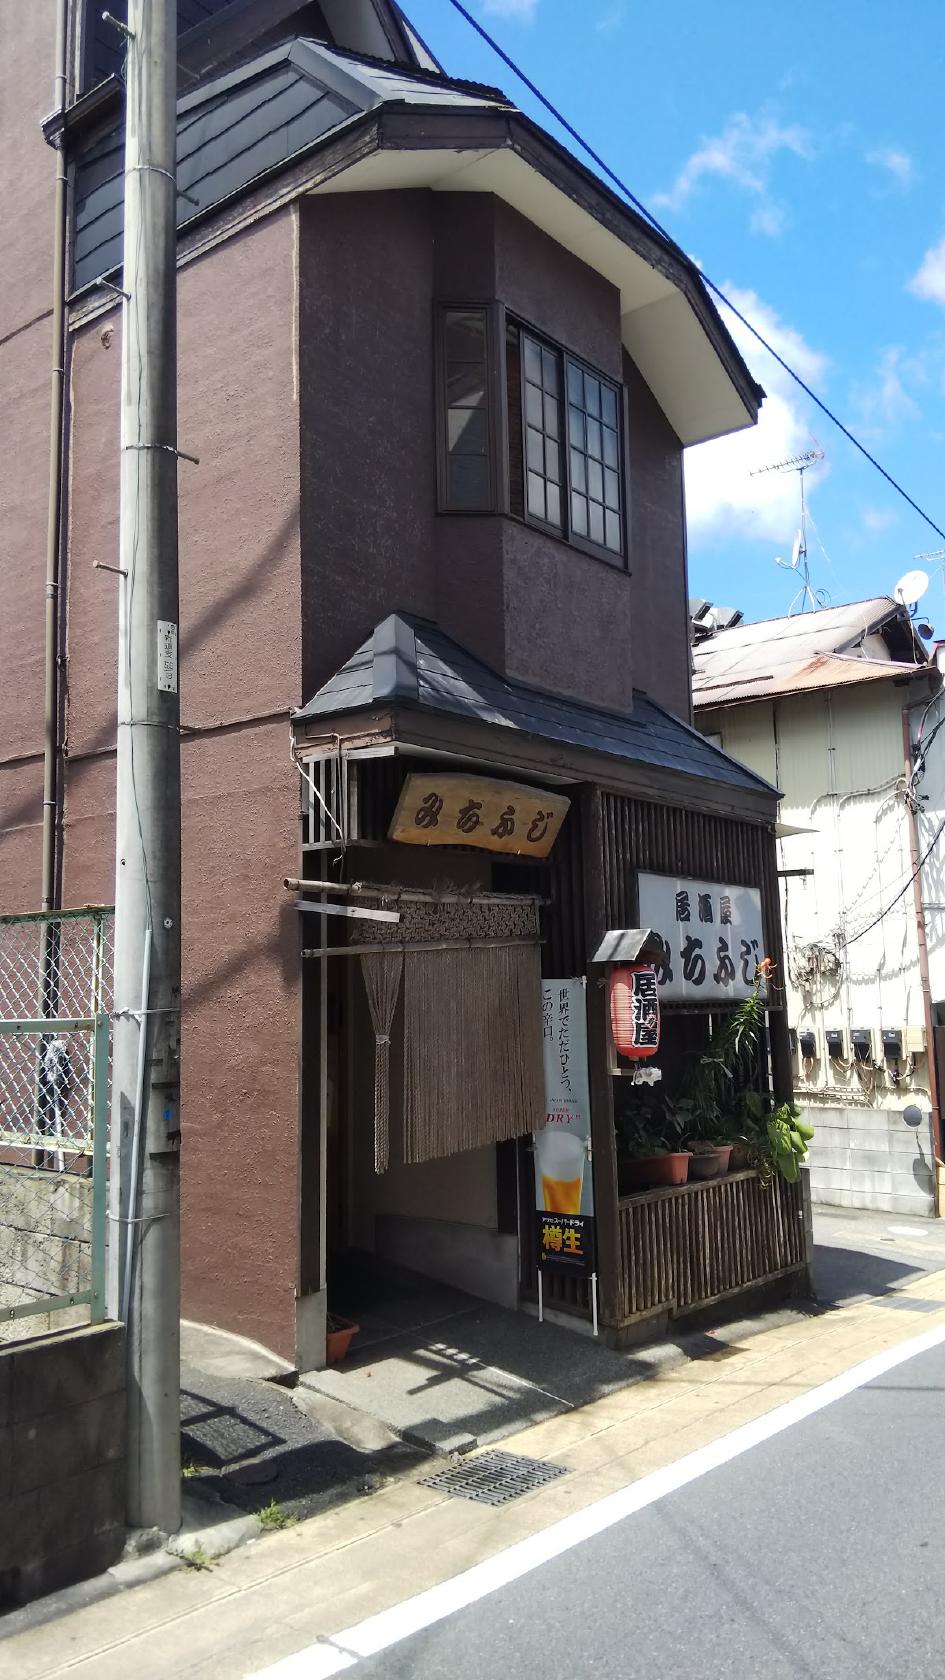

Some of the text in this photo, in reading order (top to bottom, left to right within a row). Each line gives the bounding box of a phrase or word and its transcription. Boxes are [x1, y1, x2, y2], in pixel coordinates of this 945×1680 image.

[414, 792, 554, 843] みちふじ
[675, 890, 733, 926] 居酒屋
[632, 972, 659, 1048] 居酒屋
[542, 1225, 585, 1256] 樽生
